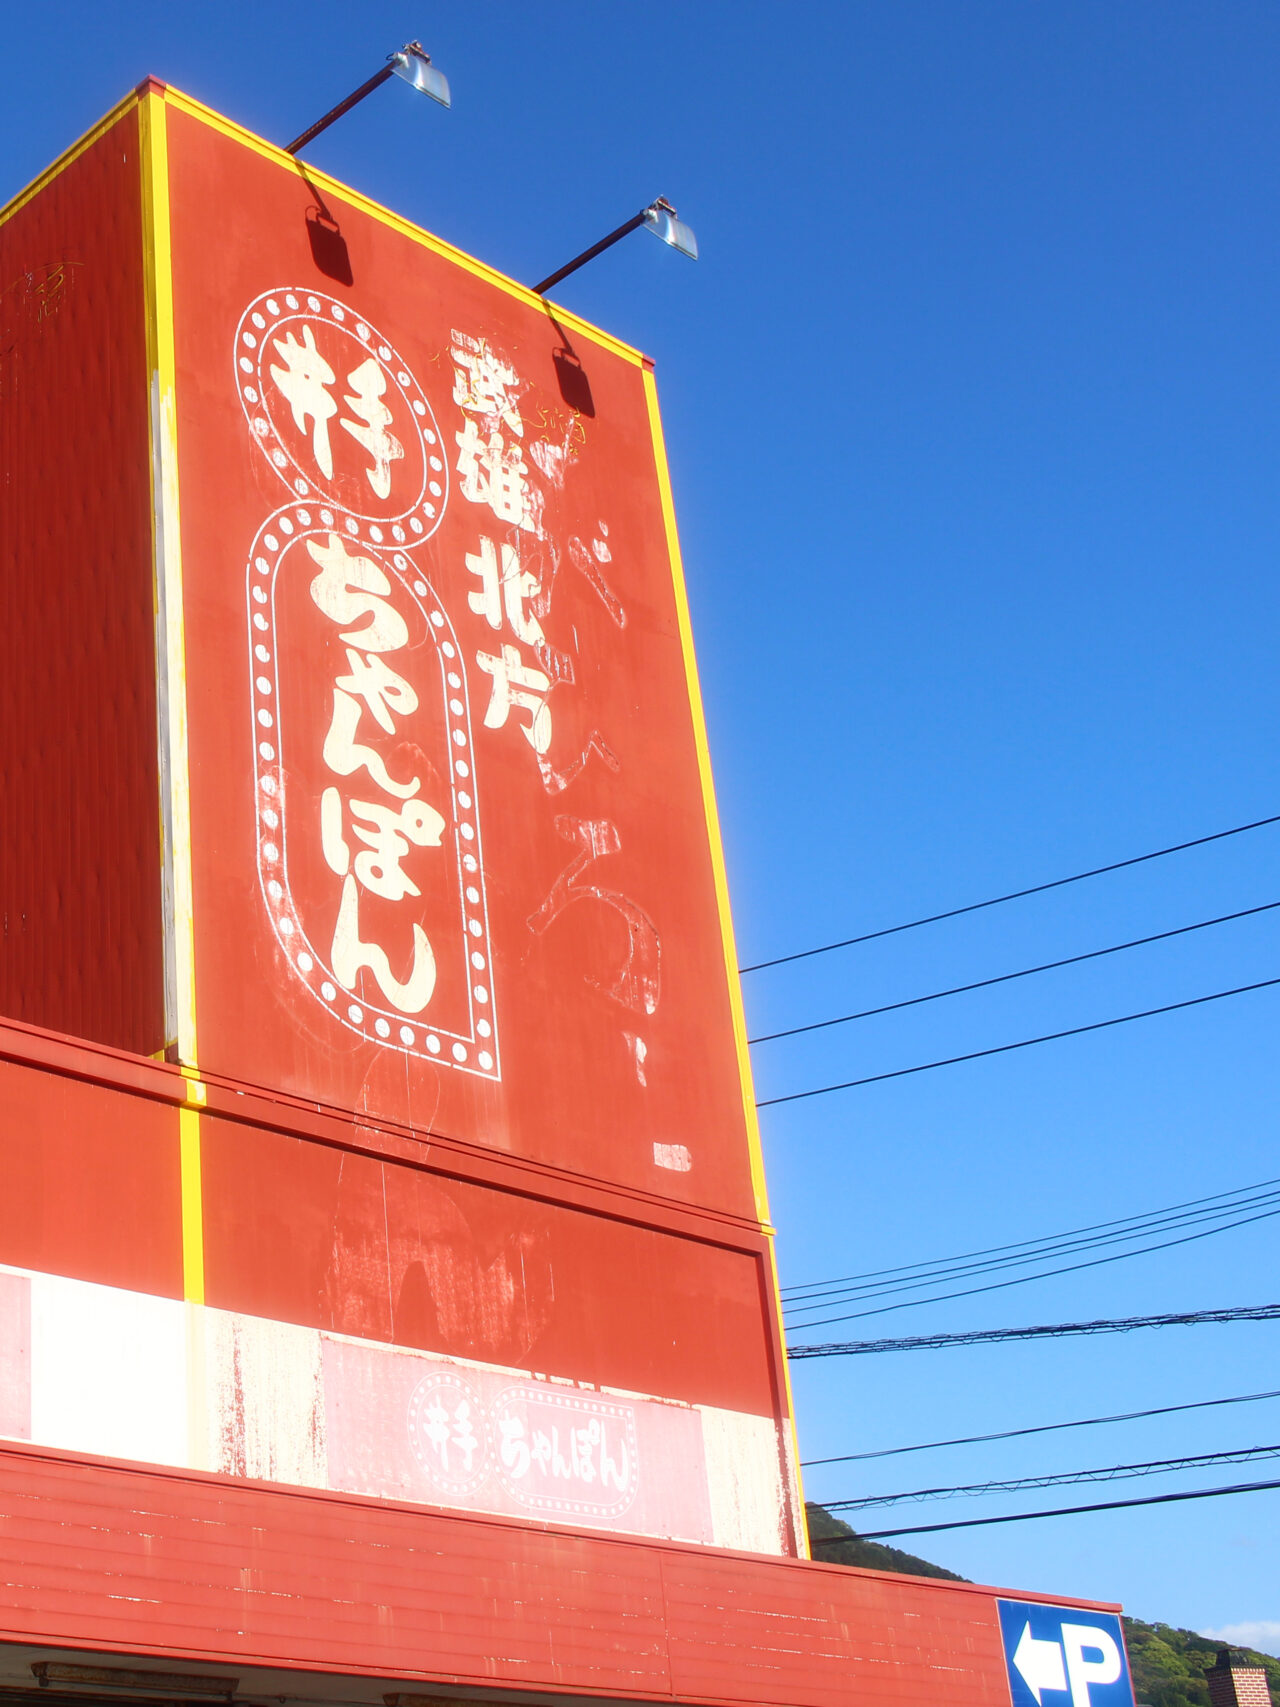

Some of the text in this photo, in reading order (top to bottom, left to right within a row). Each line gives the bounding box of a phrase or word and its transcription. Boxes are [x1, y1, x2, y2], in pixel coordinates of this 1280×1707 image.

[306, 533, 447, 1014] ちゃんぽん
[497, 1408, 629, 1492] ちゃんぽん
[1060, 1622, 1122, 1707] P
